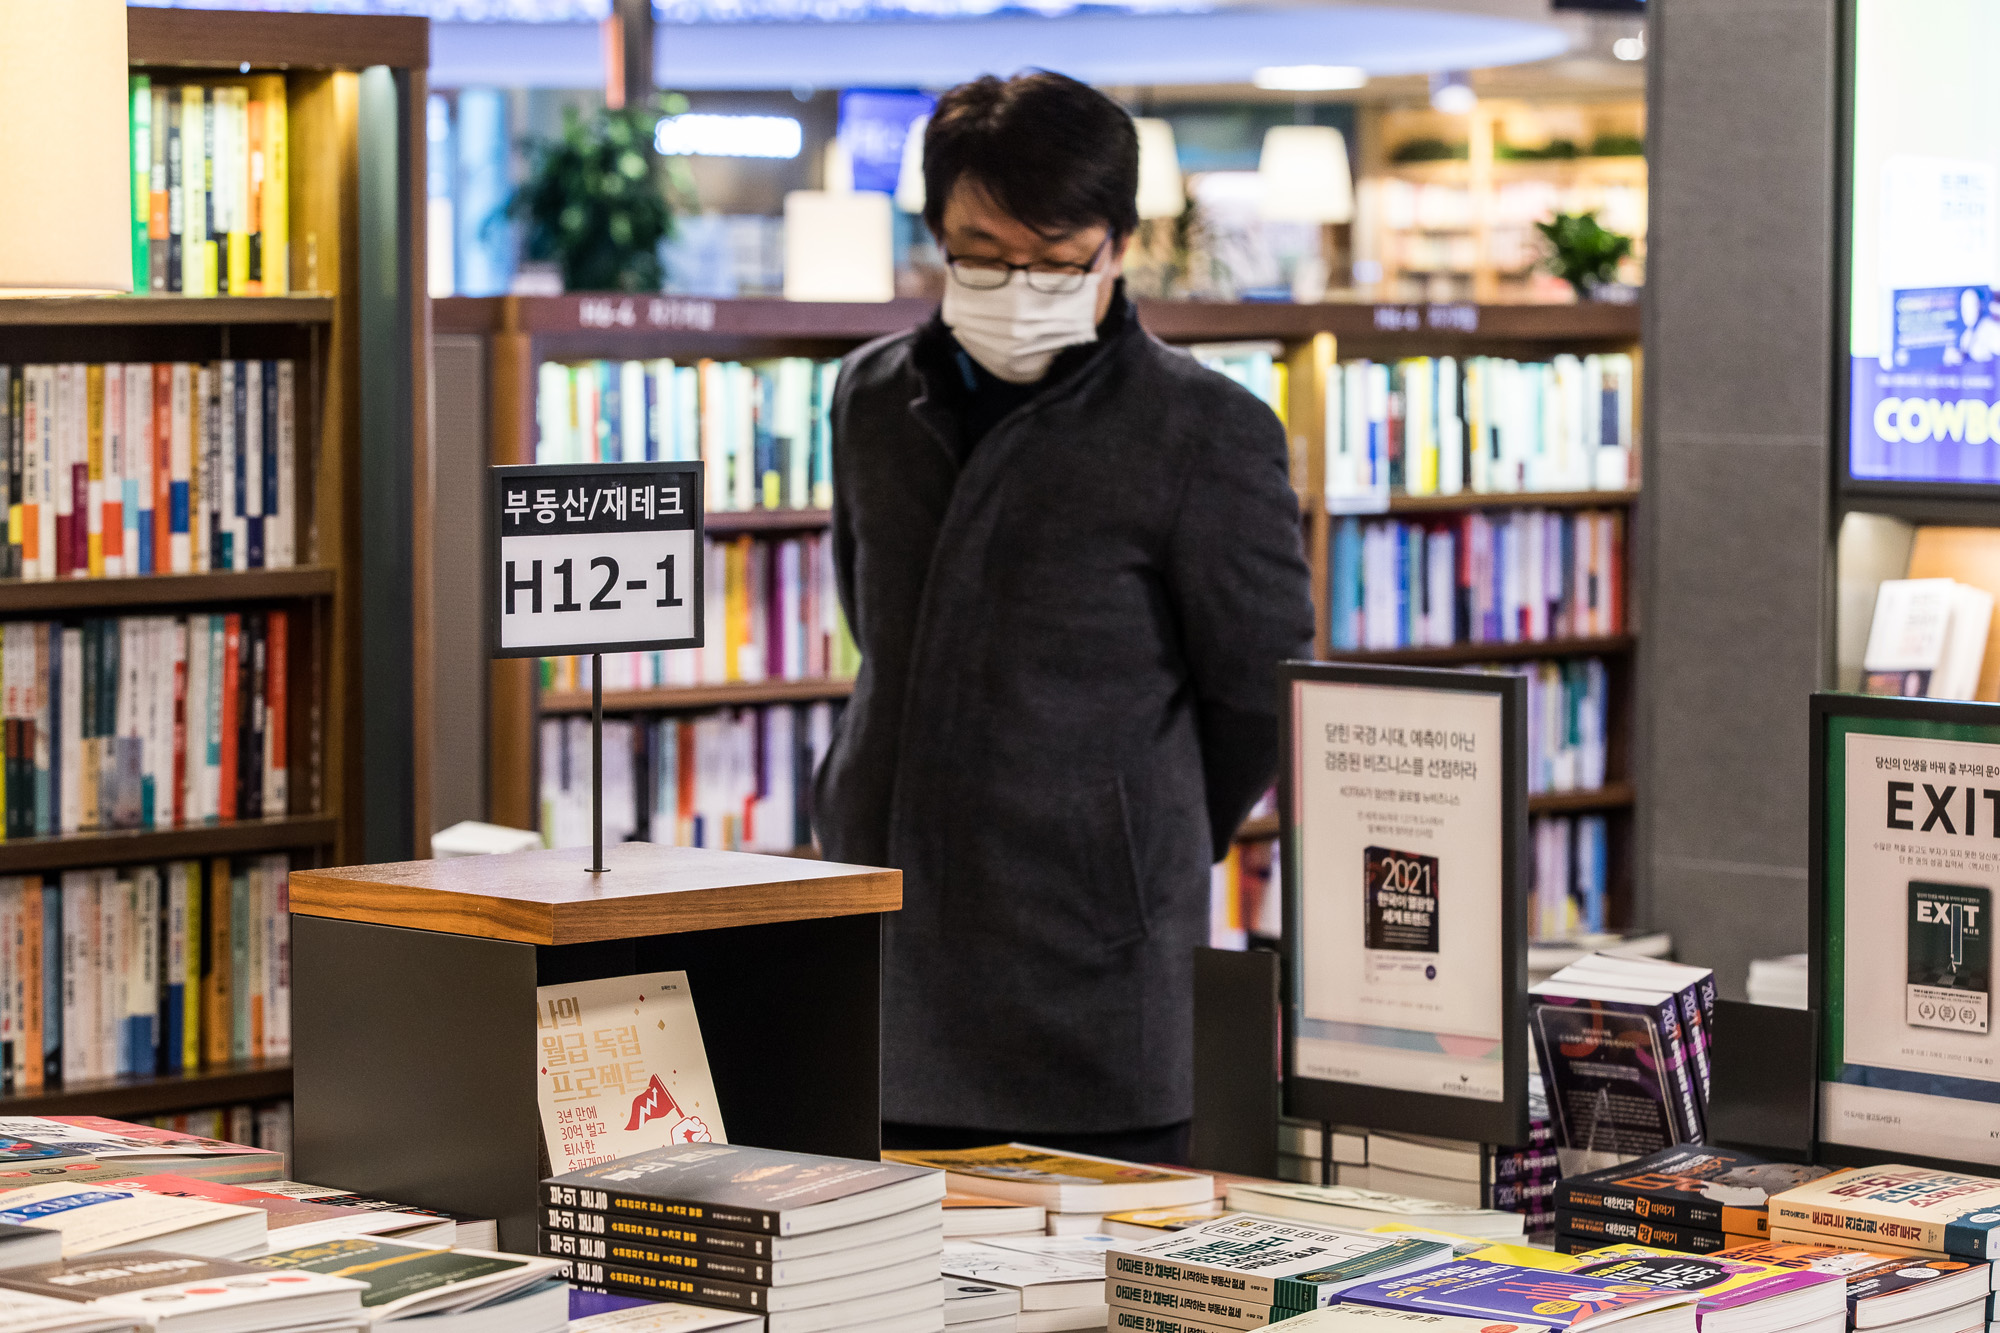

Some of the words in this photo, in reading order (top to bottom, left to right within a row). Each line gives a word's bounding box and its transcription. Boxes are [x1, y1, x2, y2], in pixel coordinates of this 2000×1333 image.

[504, 485, 684, 525] 부동산/재테크
[505, 554, 683, 615] H12-1
[1325, 723, 1349, 743] 닫힌
[1353, 724, 1377, 745] 국경
[1380, 727, 1408, 747] 시대,
[1410, 729, 1447, 749] 예측이
[1451, 732, 1475, 752] 아닌
[1325, 751, 1360, 772] 검증된
[1364, 755, 1423, 777] 비즈니스를
[1427, 759, 1477, 780] 선점하라
[1875, 756, 1900, 770] 당신의
[1902, 759, 1927, 772] 인생을
[1929, 762, 1947, 774] 바꿔
[1948, 762, 1957, 775] 줄
[1958, 763, 1984, 777] 부자의
[1929, 847, 1948, 856] 부자가
[1950, 848, 1962, 858] 되지
[1381, 857, 1430, 895] 2021
[537, 997, 582, 1029] 나의
[1662, 1004, 1680, 1040] 2021
[1683, 991, 1698, 1025] 2021
[542, 1033, 589, 1067] 월급
[593, 1025, 642, 1059] 독립
[550, 1060, 651, 1103] 프로젝트
[557, 1110, 573, 1124] 3년
[575, 1106, 598, 1122] 만에
[560, 1127, 583, 1141] 30억
[586, 1122, 607, 1137] 벌고
[563, 1140, 596, 1156] 퇴사한
[1604, 1196, 1635, 1212] 대한민국
[1637, 1198, 1649, 1216] 땅
[1651, 1203, 1675, 1217] 따먹기
[1605, 1222, 1637, 1238] 대한민국
[1639, 1225, 1652, 1243] 땅
[1653, 1230, 1678, 1244] 따먹기
[1812, 1211, 1844, 1229] 돈되는
[1845, 1216, 1878, 1234] 천만원
[555, 1262, 573, 1279] 의
[1117, 1257, 1143, 1274] 아파트
[1144, 1261, 1154, 1276] 한
[1155, 1263, 1181, 1281] 채부터
[1182, 1270, 1209, 1284] 시작하는
[1211, 1274, 1231, 1287] 부동산
[1232, 1278, 1245, 1290] 절세
[1116, 1285, 1141, 1302] 아파트
[1143, 1289, 1152, 1303] 한
[1153, 1291, 1178, 1309] 채부터
[1180, 1297, 1206, 1312] 시작하는
[1208, 1303, 1227, 1316] 부동산
[1228, 1306, 1241, 1318] 절세
[1118, 1313, 1144, 1330] 아파트
[1146, 1317, 1155, 1332] 한
